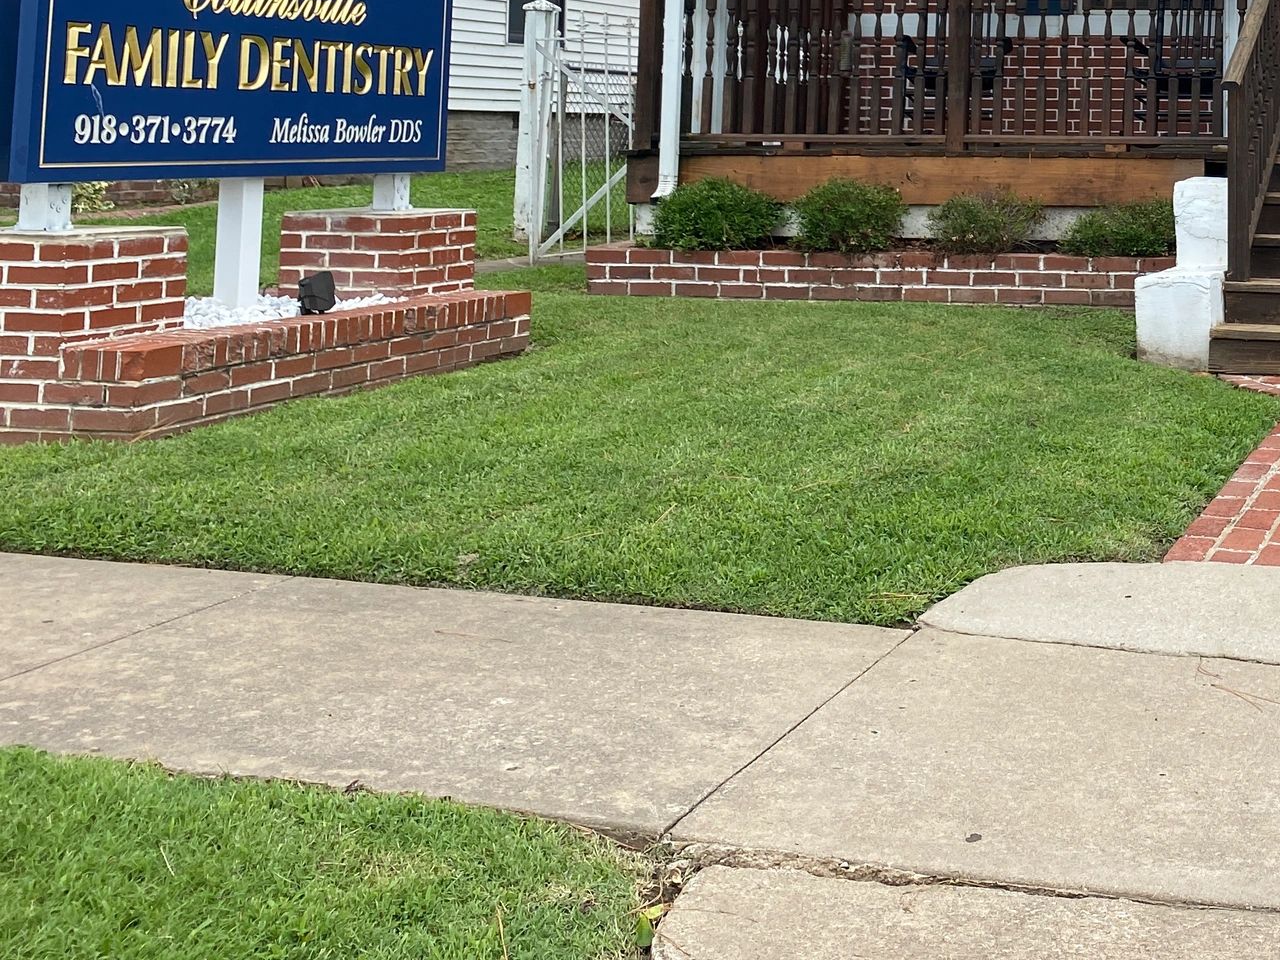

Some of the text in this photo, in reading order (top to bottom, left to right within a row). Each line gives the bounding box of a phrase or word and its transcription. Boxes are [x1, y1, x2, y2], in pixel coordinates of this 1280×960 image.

[63, 21, 434, 97] FAMILY DENTISTRY
[269, 112, 423, 144] Melissa Bowler DDS
